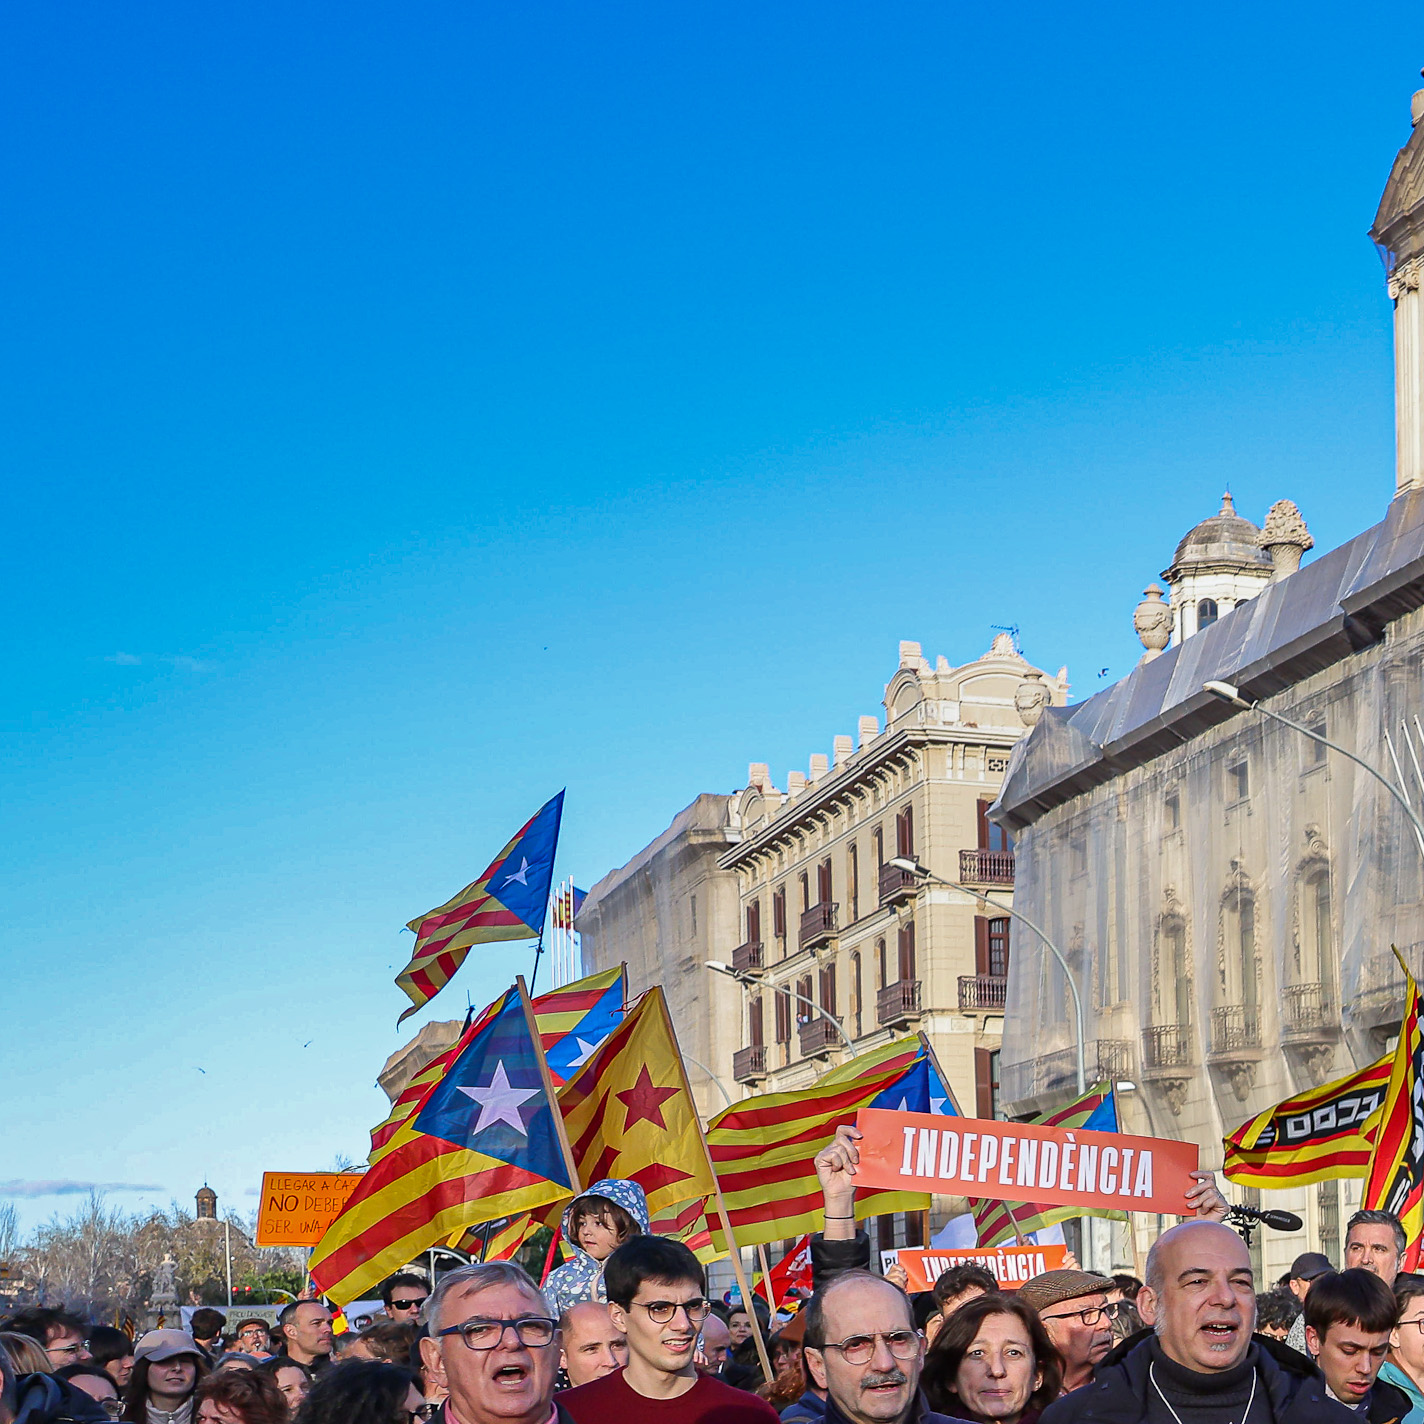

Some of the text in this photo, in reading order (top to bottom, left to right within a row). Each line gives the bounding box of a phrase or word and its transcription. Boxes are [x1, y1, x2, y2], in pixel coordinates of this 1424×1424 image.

[899, 1126, 1154, 1198] INDEPENDÈNCIA
[270, 1178, 356, 1192] LLEGAR A CAS
[268, 1194, 299, 1212] NO
[265, 1219, 293, 1234] SER
[300, 1219, 323, 1234] UNA
